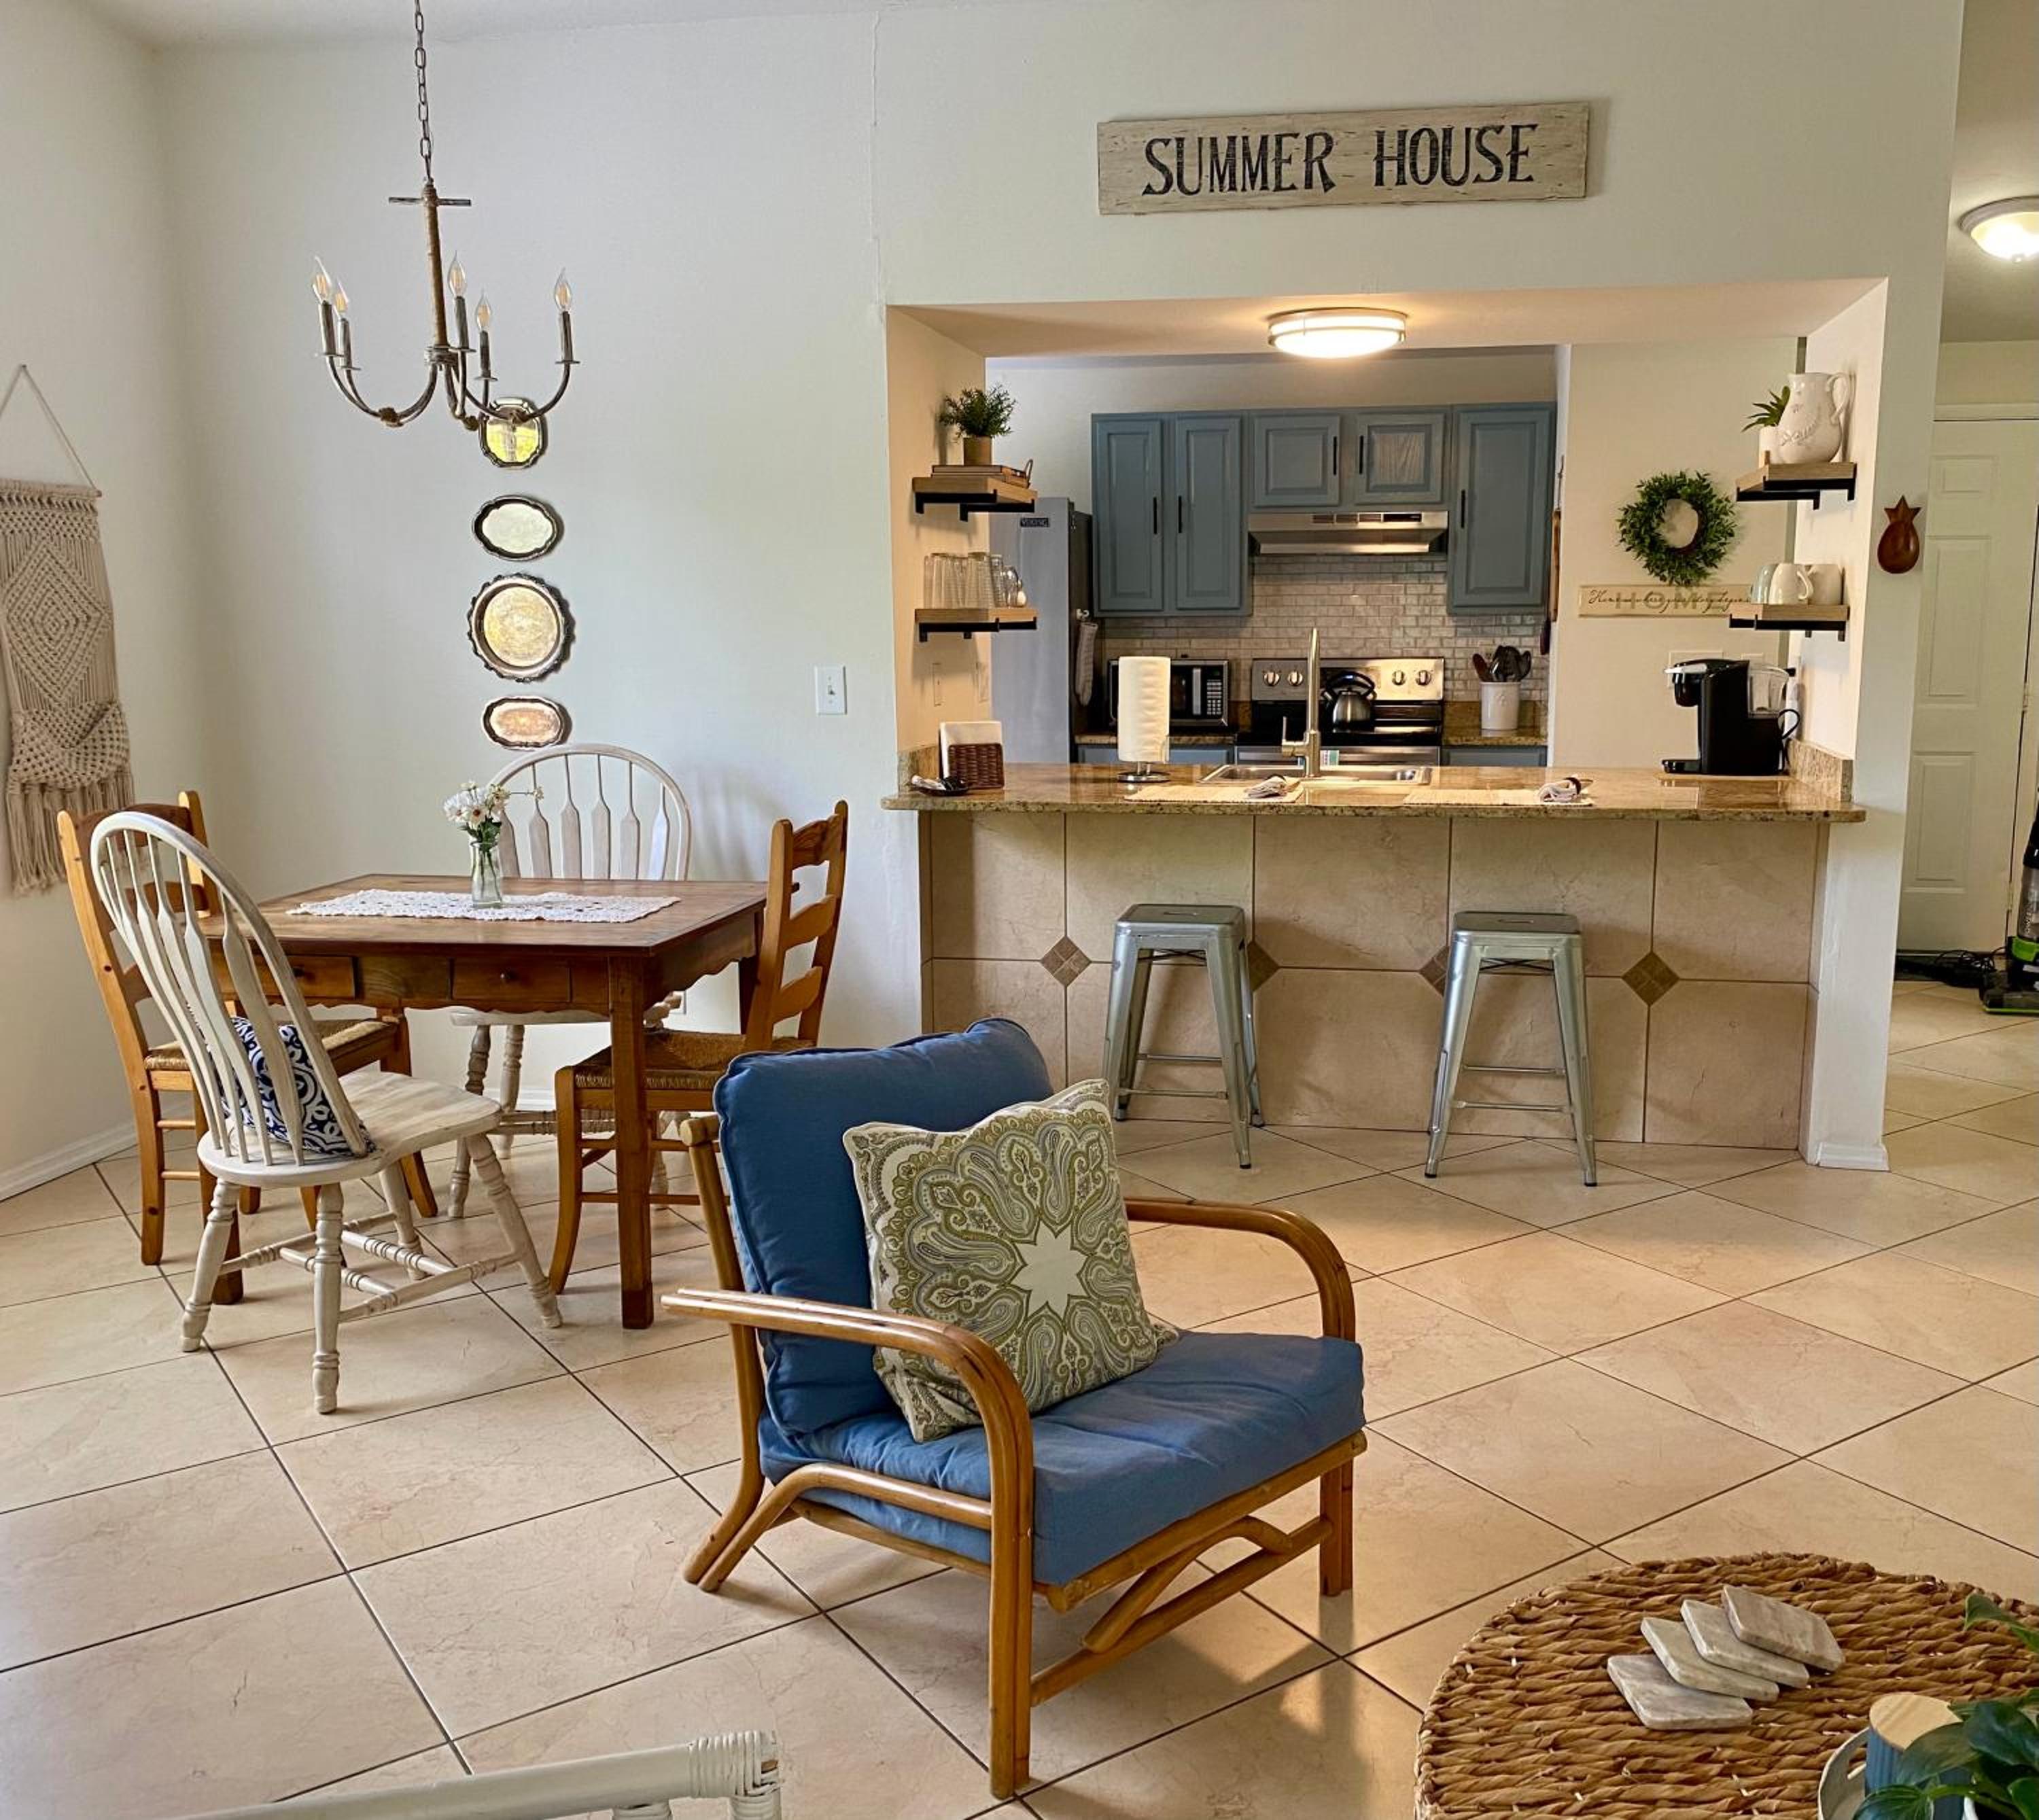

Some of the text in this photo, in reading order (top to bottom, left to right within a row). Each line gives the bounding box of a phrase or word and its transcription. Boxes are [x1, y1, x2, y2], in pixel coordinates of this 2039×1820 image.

[1142, 123, 1538, 196] SUMMER HOUSE
[1615, 591, 1724, 610] HOME
